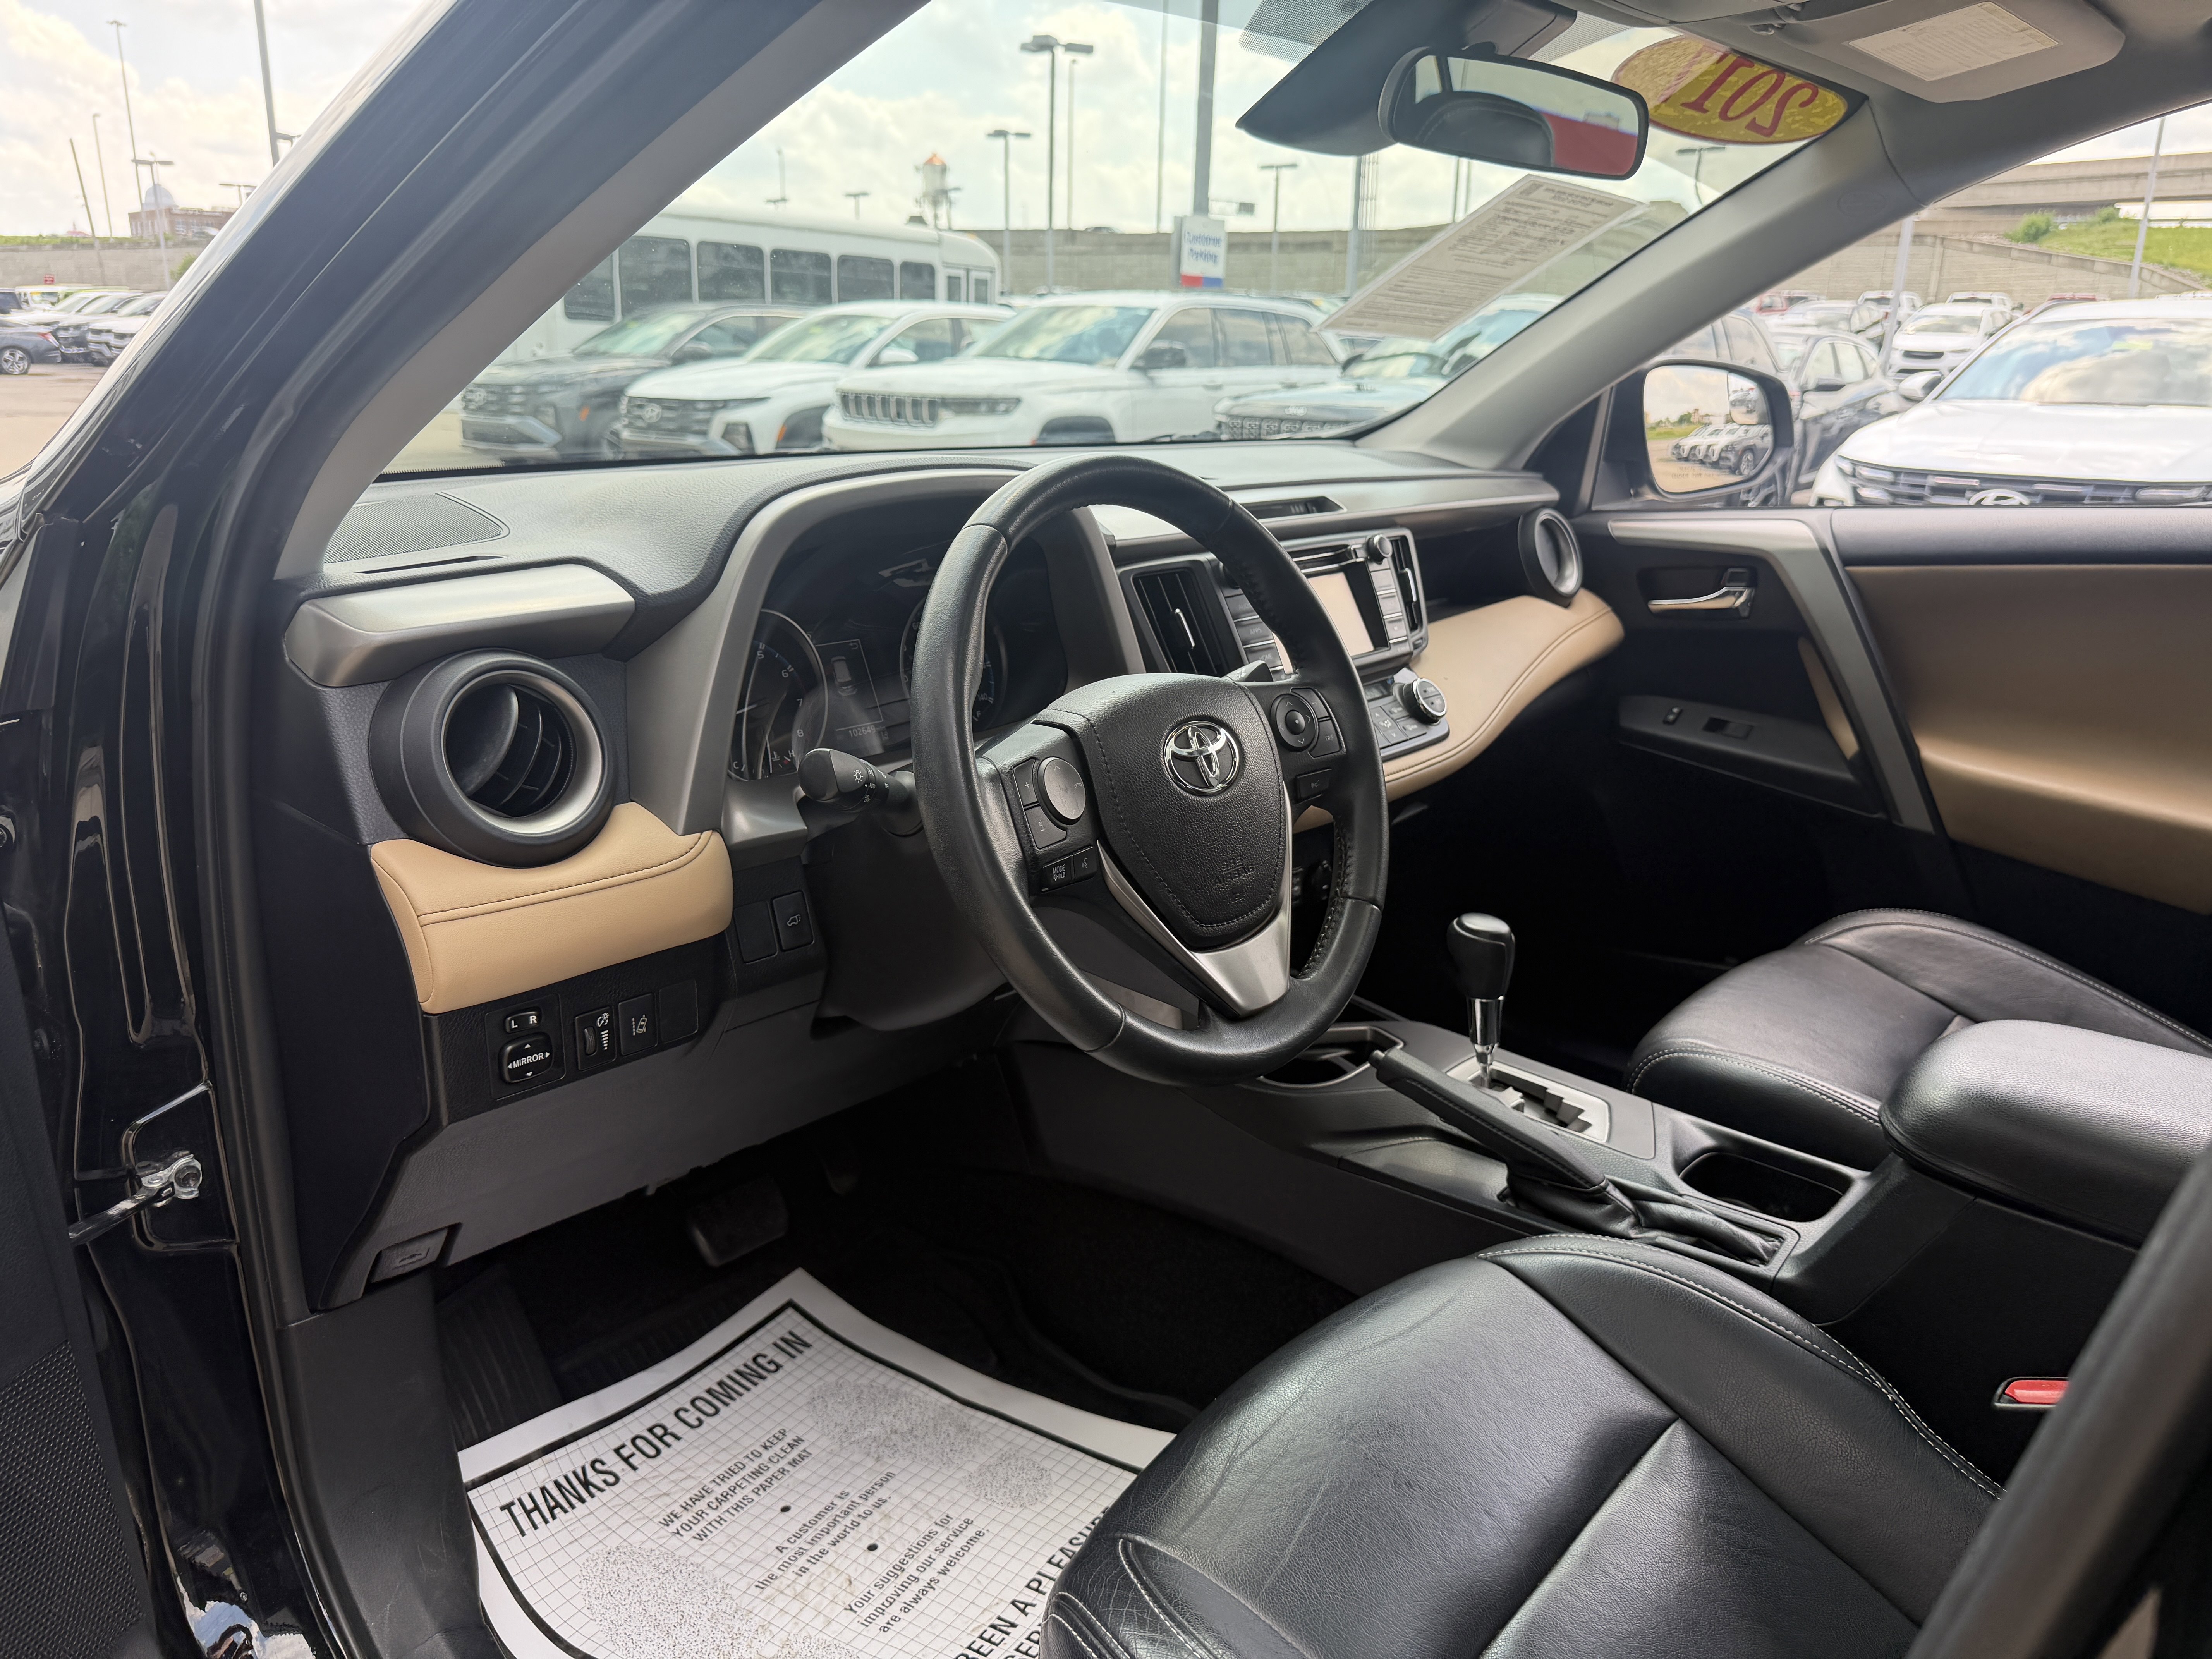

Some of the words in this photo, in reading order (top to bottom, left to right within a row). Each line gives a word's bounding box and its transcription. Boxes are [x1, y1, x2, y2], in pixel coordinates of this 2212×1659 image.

[757, 651, 764, 659] 5
[781, 669, 789, 678] 6
[796, 698, 803, 707] 7
[797, 729, 804, 737] 8
[849, 725, 876, 737] 102649
[1053, 864, 1065, 874] MODE
[511, 1020, 518, 1029] L
[529, 1015, 538, 1024] R
[513, 1053, 544, 1068] MIRROR
[500, 1458, 620, 1537] THANKS
[614, 1422, 682, 1471] FOR
[674, 1352, 783, 1429] COMING
[773, 1330, 812, 1359] IN
[659, 1510, 683, 1527] WE
[679, 1484, 714, 1511] HAVE
[711, 1460, 747, 1488] TRIED
[743, 1449, 763, 1463] TO
[761, 1428, 787, 1451] KEEP
[672, 1510, 709, 1537] YOUR
[707, 1462, 770, 1510] CARPETING
[768, 1435, 805, 1464] CLEAN
[692, 1515, 728, 1541] WITH
[726, 1494, 754, 1517] THIS
[752, 1467, 790, 1496] PAPER
[788, 1448, 812, 1468] MAT
[755, 1573, 778, 1590] the
[777, 1546, 807, 1572] most
[805, 1499, 860, 1546] important
[858, 1471, 896, 1501] person
[775, 1545, 788, 1553] A
[787, 1500, 838, 1544] customer
[836, 1490, 850, 1500] is
[792, 1565, 810, 1577] in
[807, 1547, 829, 1565] the
[828, 1520, 860, 1547] world
[857, 1509, 873, 1520] to
[872, 1496, 891, 1510] us.
[843, 1589, 875, 1615] Your
[874, 1528, 939, 1590] suggestions
[934, 1513, 955, 1528] for
[857, 1573, 920, 1627] improving
[916, 1554, 936, 1573] our
[934, 1517, 974, 1554] service
[879, 1614, 902, 1633] are
[900, 1576, 940, 1614] always
[938, 1528, 989, 1576] welcome.
[1010, 1598, 1038, 1617] A
